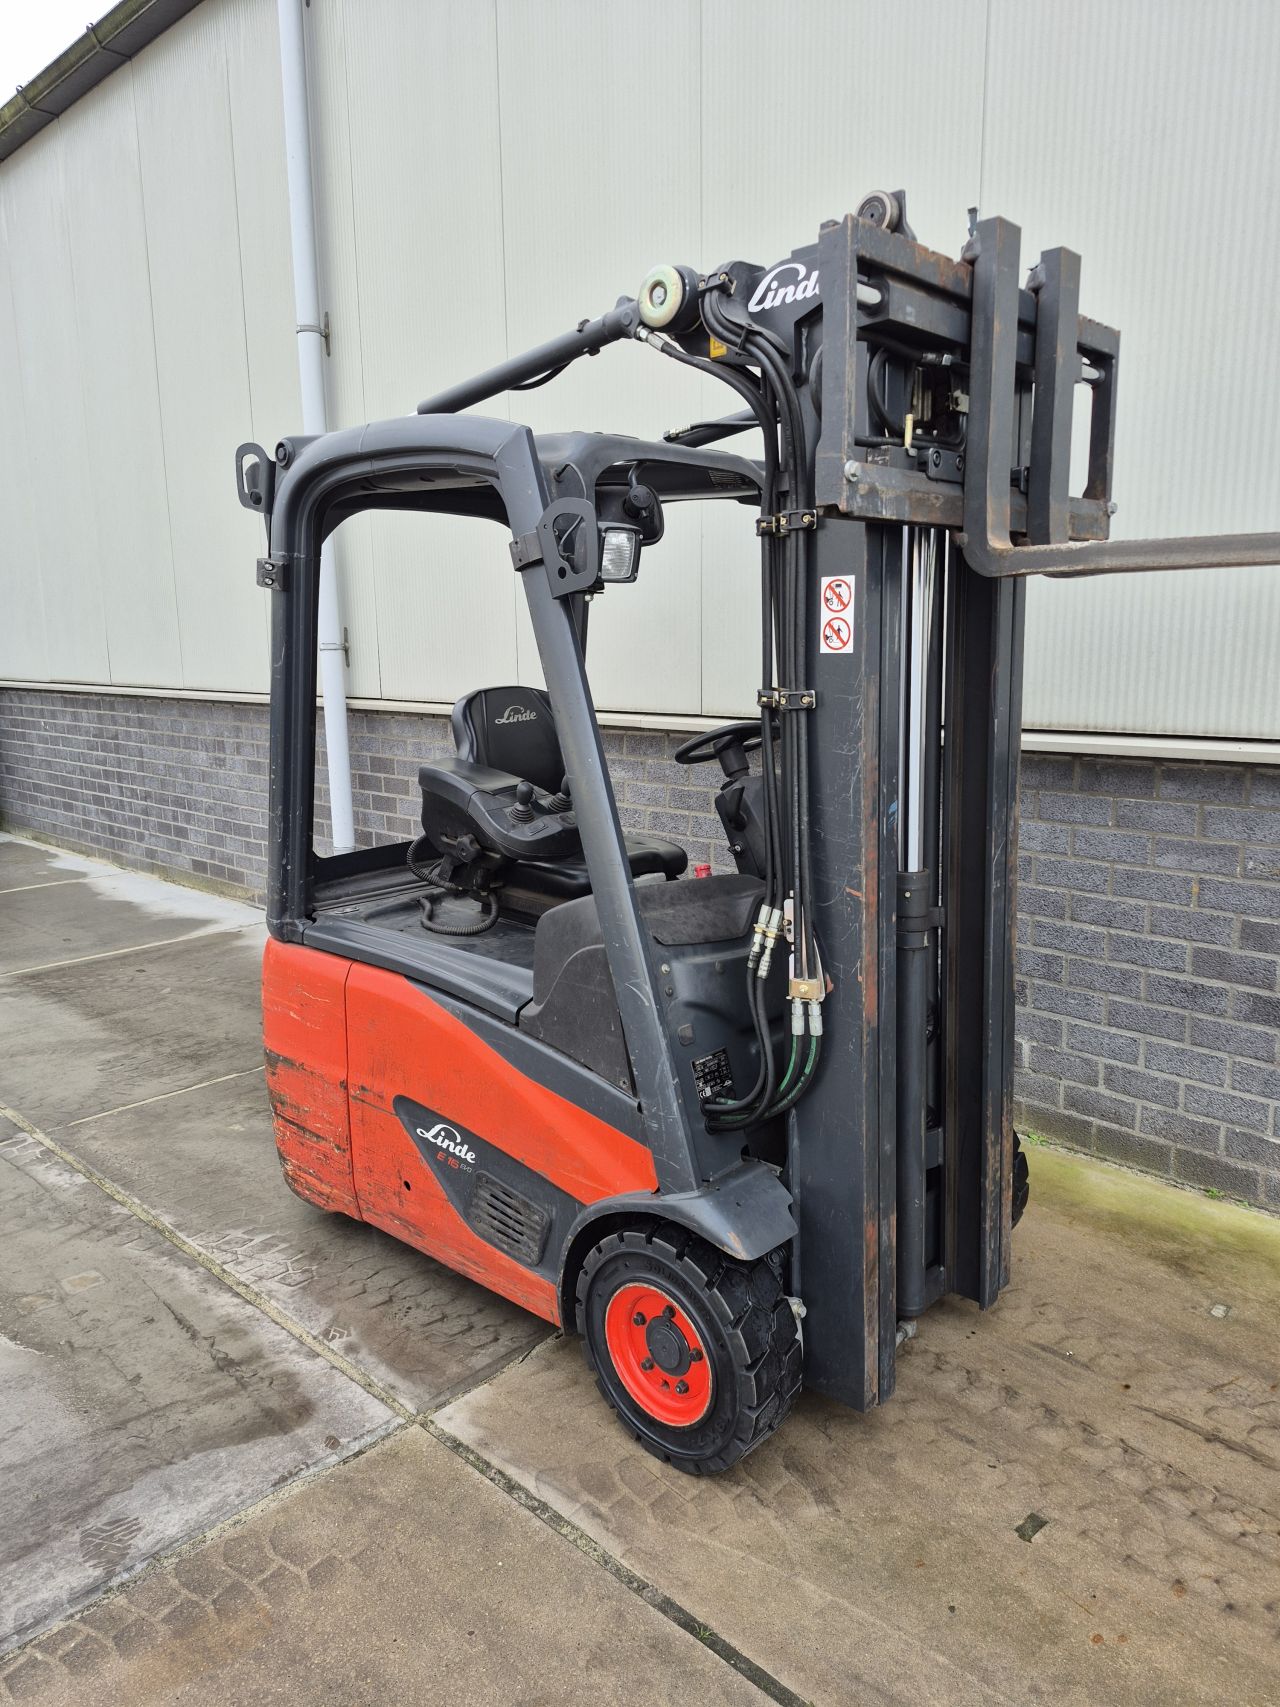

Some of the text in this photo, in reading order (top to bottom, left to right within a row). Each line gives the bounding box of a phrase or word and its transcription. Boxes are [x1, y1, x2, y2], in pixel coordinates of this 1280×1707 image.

[747, 263, 820, 313] Lind
[495, 705, 537, 725] Linde
[416, 1124, 476, 1164] Linde
[437, 1151, 446, 1161] E
